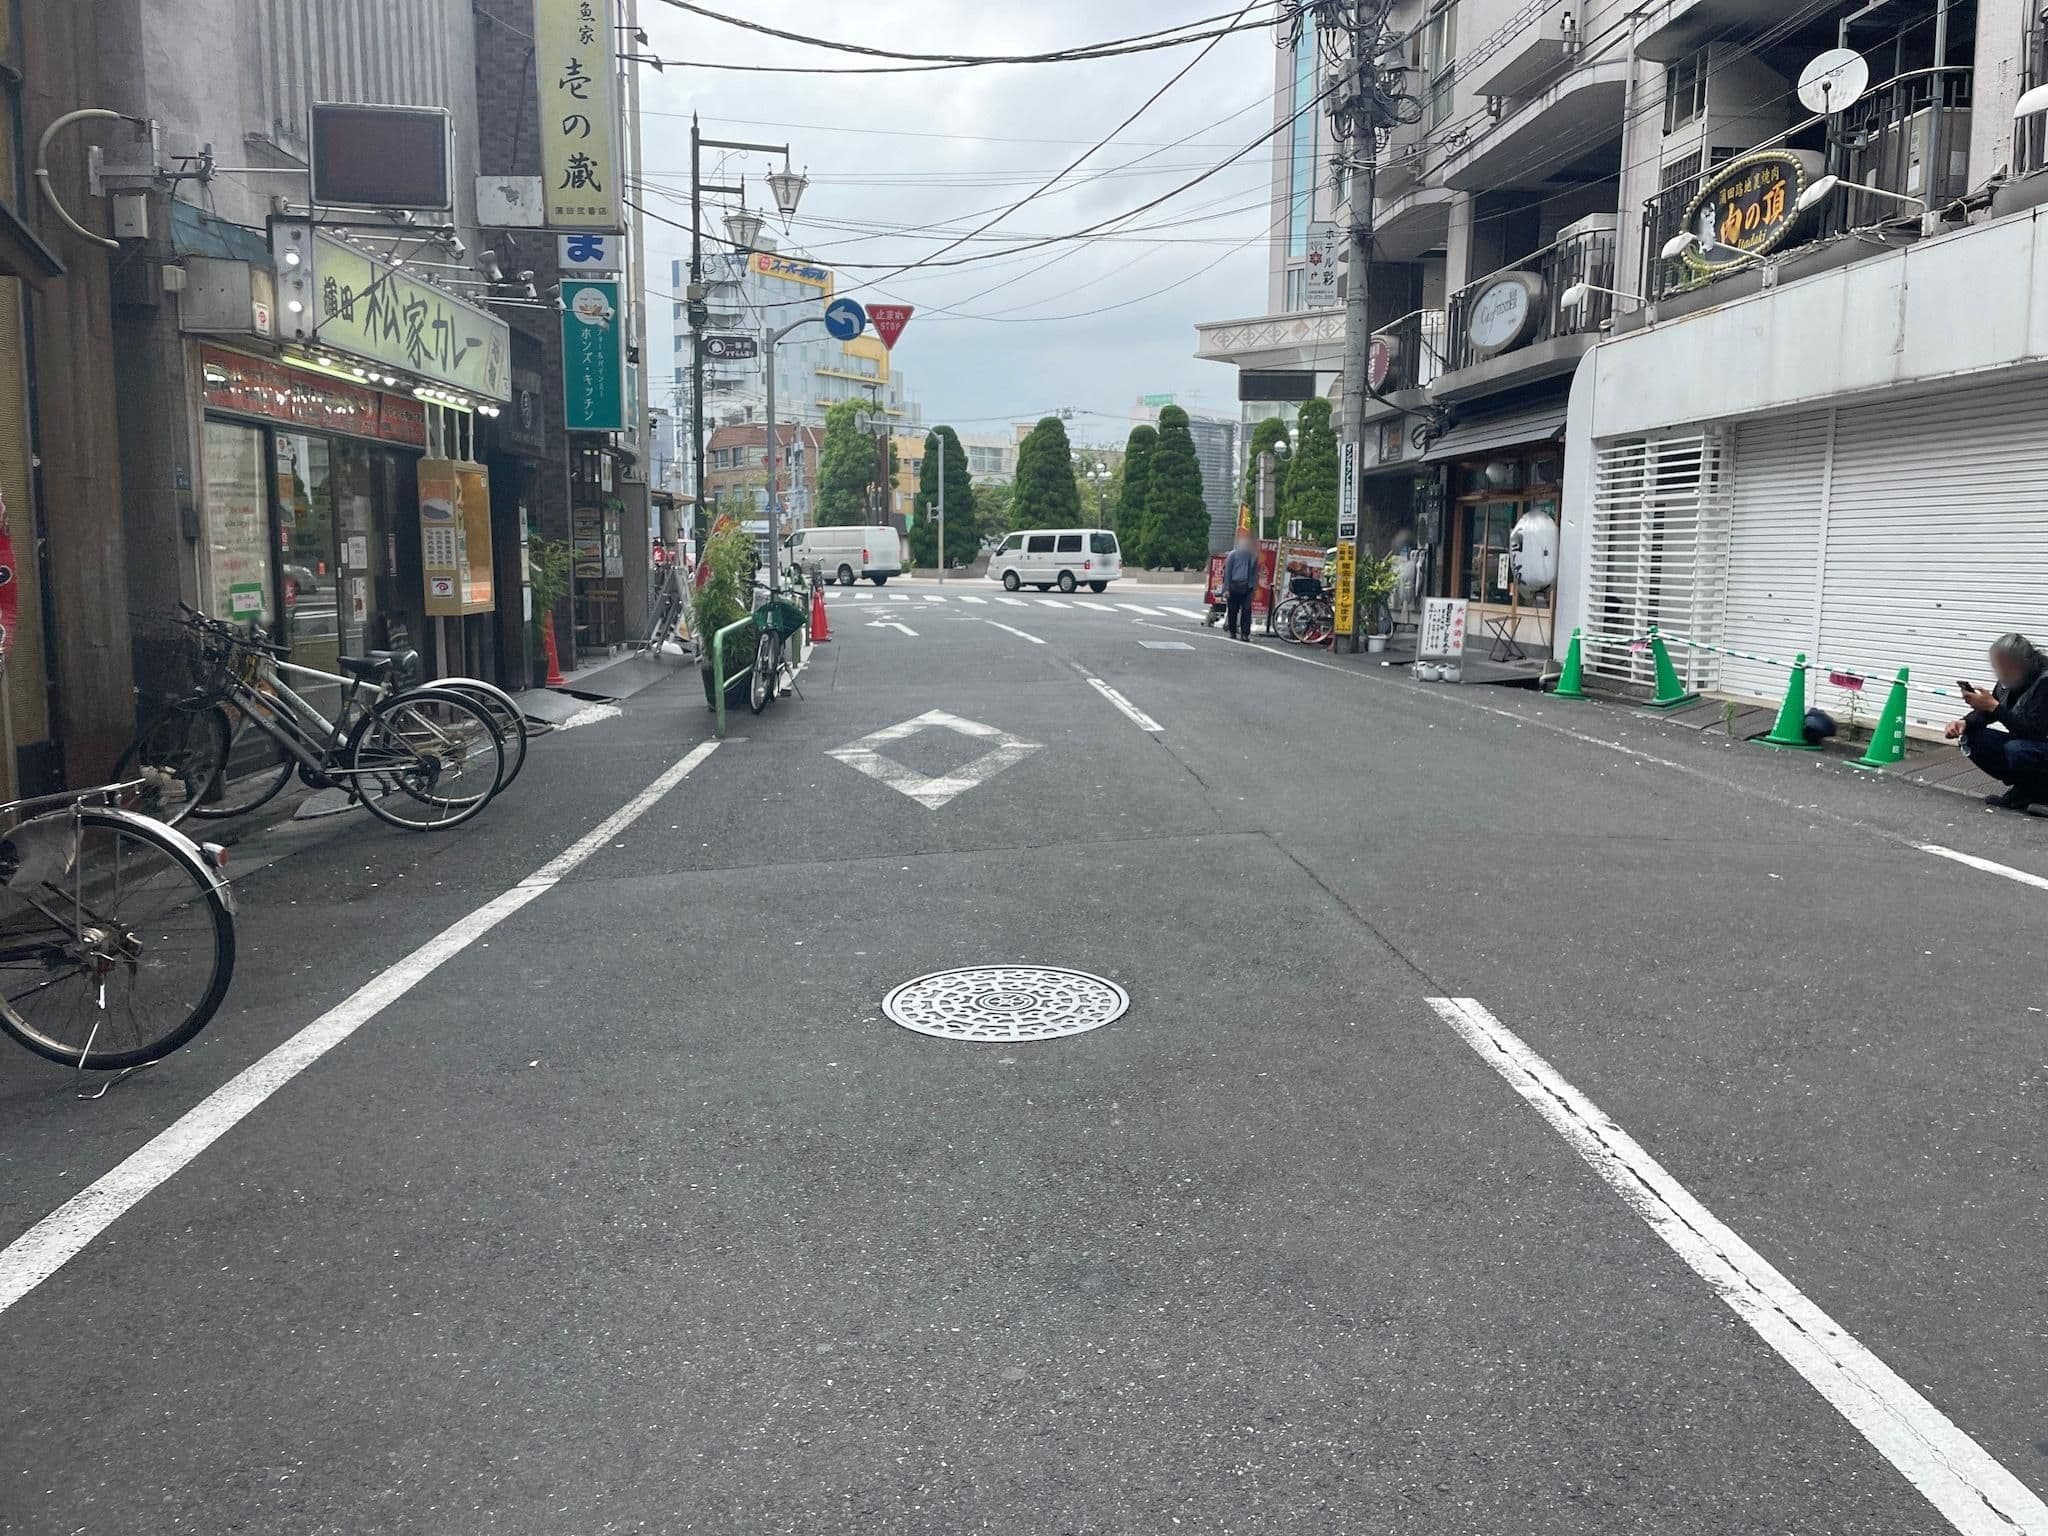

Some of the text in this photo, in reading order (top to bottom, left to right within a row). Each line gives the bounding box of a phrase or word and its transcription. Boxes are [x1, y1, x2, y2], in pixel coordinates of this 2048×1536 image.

[558, 57, 603, 194] 壱の蔵
[1720, 179, 1787, 244] 肉の頂
[1322, 227, 1335, 287] ホテル彩
[363, 261, 483, 372] 松家カレー
[875, 309, 905, 320] 止まれ
[880, 321, 901, 330] STOP
